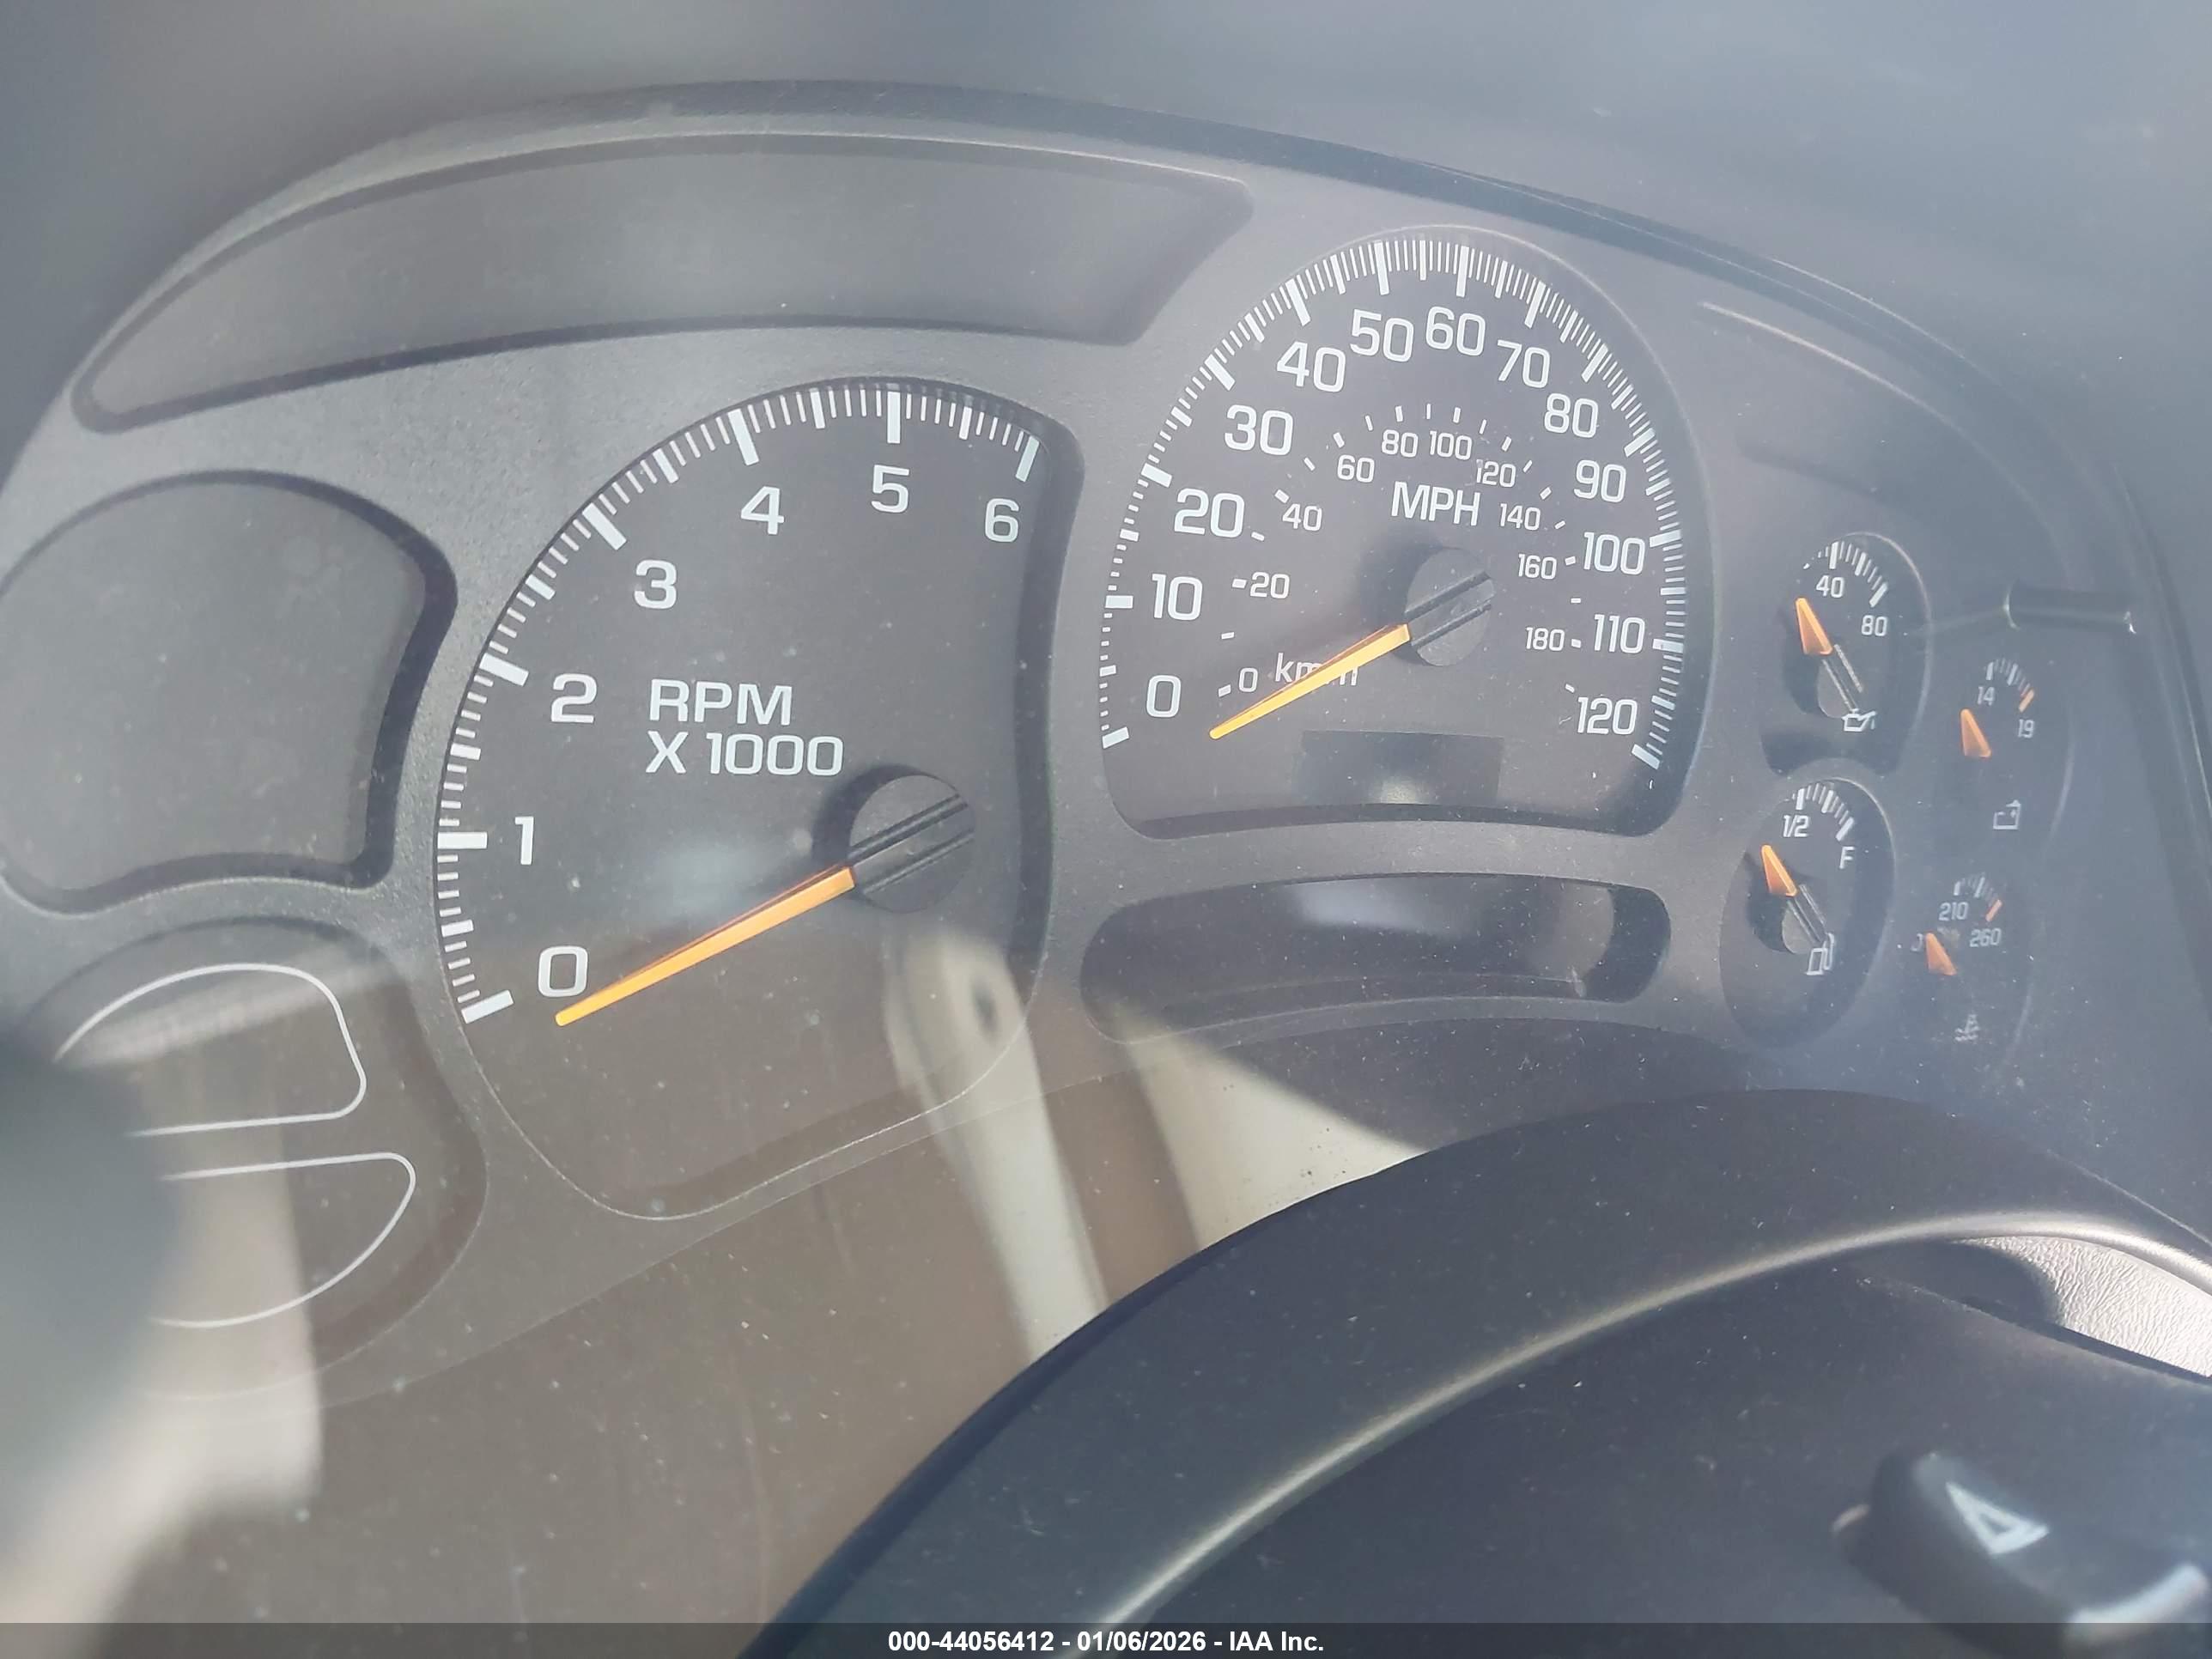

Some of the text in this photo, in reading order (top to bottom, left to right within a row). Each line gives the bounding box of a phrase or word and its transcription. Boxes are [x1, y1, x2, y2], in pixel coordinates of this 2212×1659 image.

[1349, 309, 1414, 362] 50
[1425, 307, 1486, 356] 60
[1276, 341, 1346, 392] 40
[1496, 338, 1552, 388] 70
[1224, 404, 1293, 456] 30
[1544, 392, 1599, 438] 80
[1381, 431, 1419, 459] 80
[1428, 431, 1473, 460] 100
[871, 465, 910, 514] 5
[1337, 455, 1374, 483] 60
[1474, 459, 1516, 488] 120
[1573, 460, 1626, 502] 90
[740, 485, 784, 535] 4
[984, 498, 1019, 543] 6
[1174, 489, 1245, 538] 20
[1282, 504, 1323, 532] 40
[1391, 482, 1480, 526] MPH
[1498, 503, 1541, 531] 140
[1517, 555, 1558, 580] 160
[1583, 532, 1645, 574] 100
[634, 559, 678, 610] 3
[1152, 574, 1202, 621] 10
[1250, 572, 1290, 599] 20
[1816, 574, 1845, 599] 40
[1525, 627, 1565, 652] 180
[1593, 615, 1645, 653] 110
[1861, 615, 1887, 636] 80
[550, 673, 597, 724] 2
[1146, 676, 1181, 717] 0
[1239, 668, 1258, 692] 0
[1977, 686, 1996, 706] 14
[648, 678, 793, 726] RPM
[1577, 697, 1638, 735] 120
[2018, 719, 2035, 738] 19
[646, 730, 843, 776] X 1000
[515, 816, 534, 866] 1
[1783, 815, 1809, 838] 1/2
[1839, 846, 1856, 869] F
[1938, 902, 1969, 921] 210
[1969, 927, 2002, 948] 260
[538, 945, 588, 999] 0
